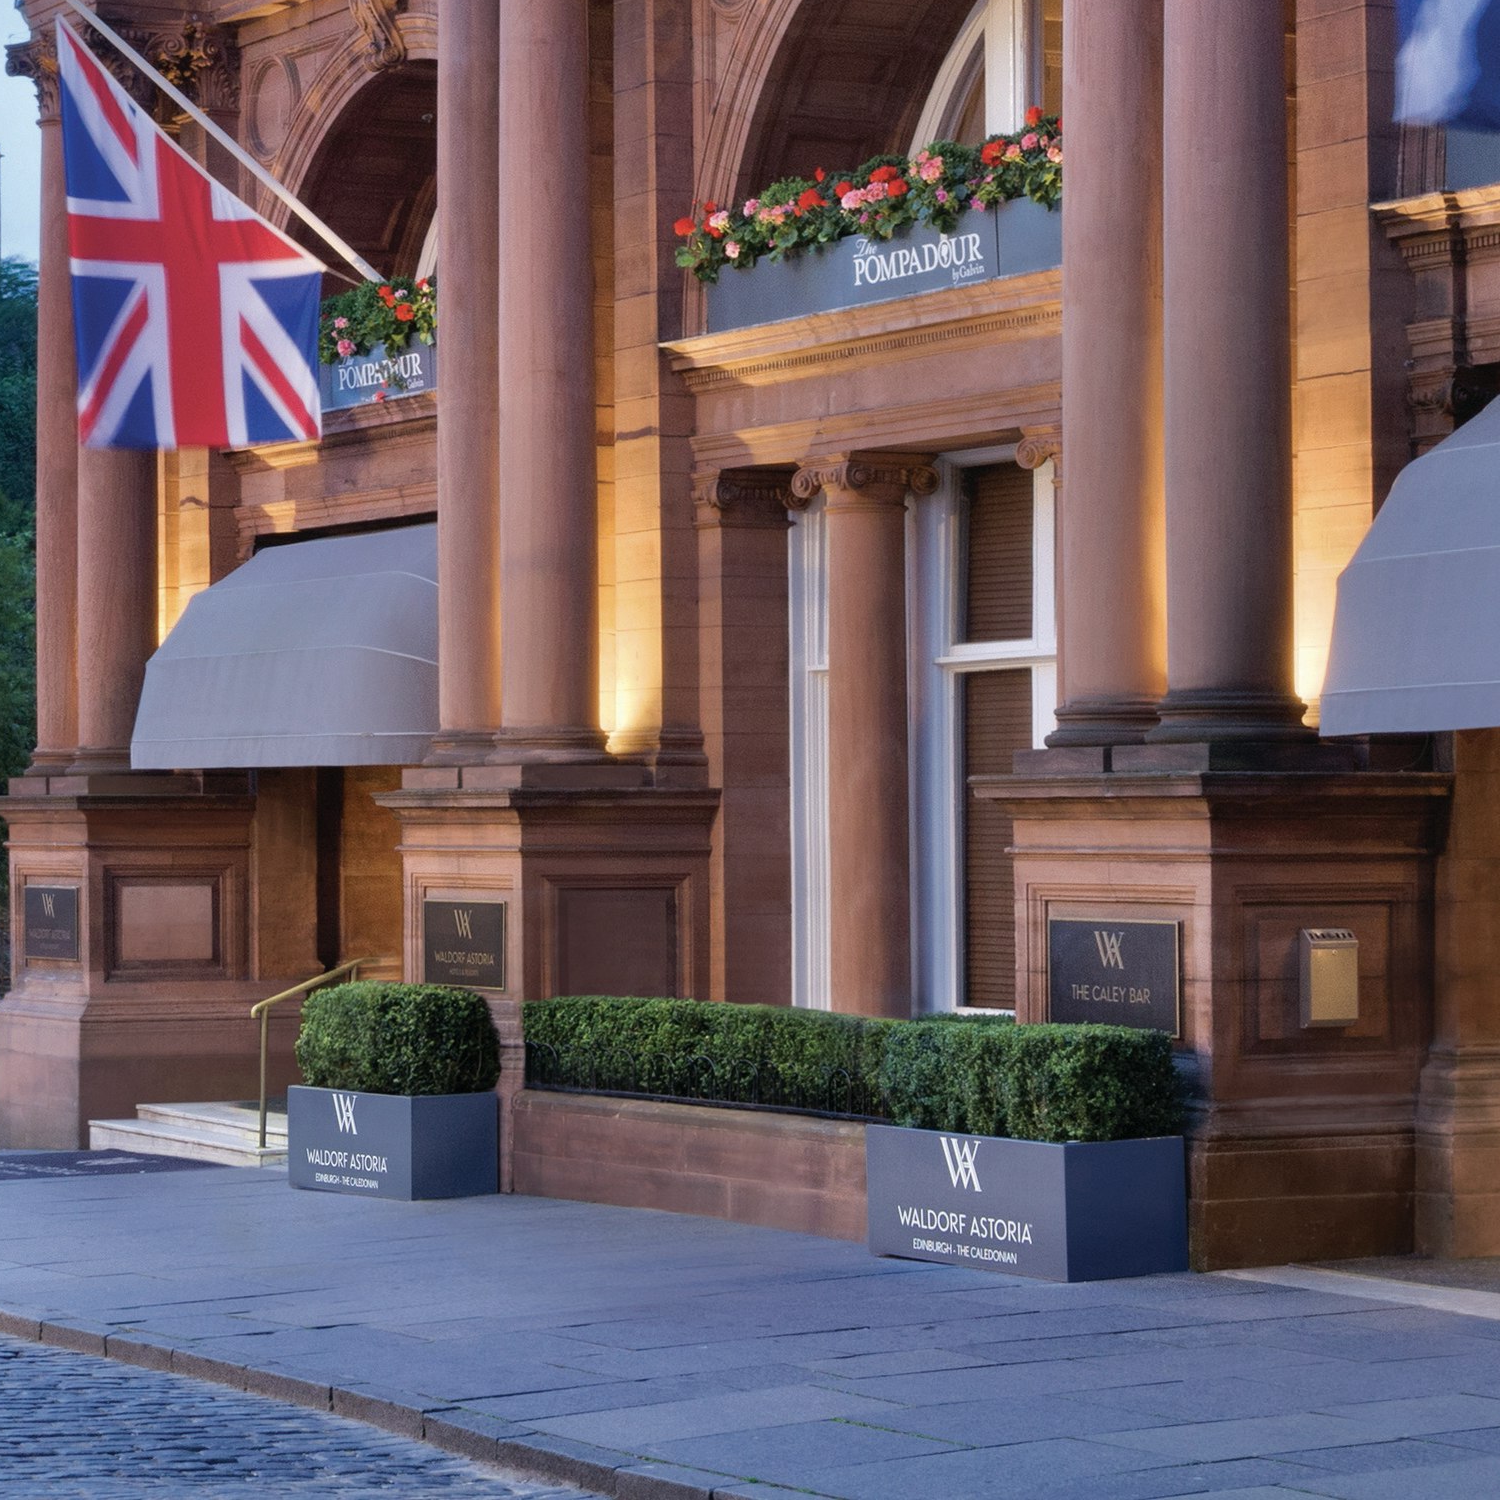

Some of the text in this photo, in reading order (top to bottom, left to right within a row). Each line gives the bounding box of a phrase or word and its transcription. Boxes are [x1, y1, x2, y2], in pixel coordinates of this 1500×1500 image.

[853, 238, 878, 258] The
[853, 233, 983, 286] POMPADOUR
[960, 263, 985, 278] Galvin
[1071, 984, 1151, 1004] THE CALEY BAR
[306, 1148, 348, 1168] WALDORF
[898, 1205, 966, 1234] WALDORF
[913, 1238, 952, 1255] EDINBURGH
[957, 1244, 970, 1258] THE
[970, 1246, 1017, 1264] CALEDONIAN
